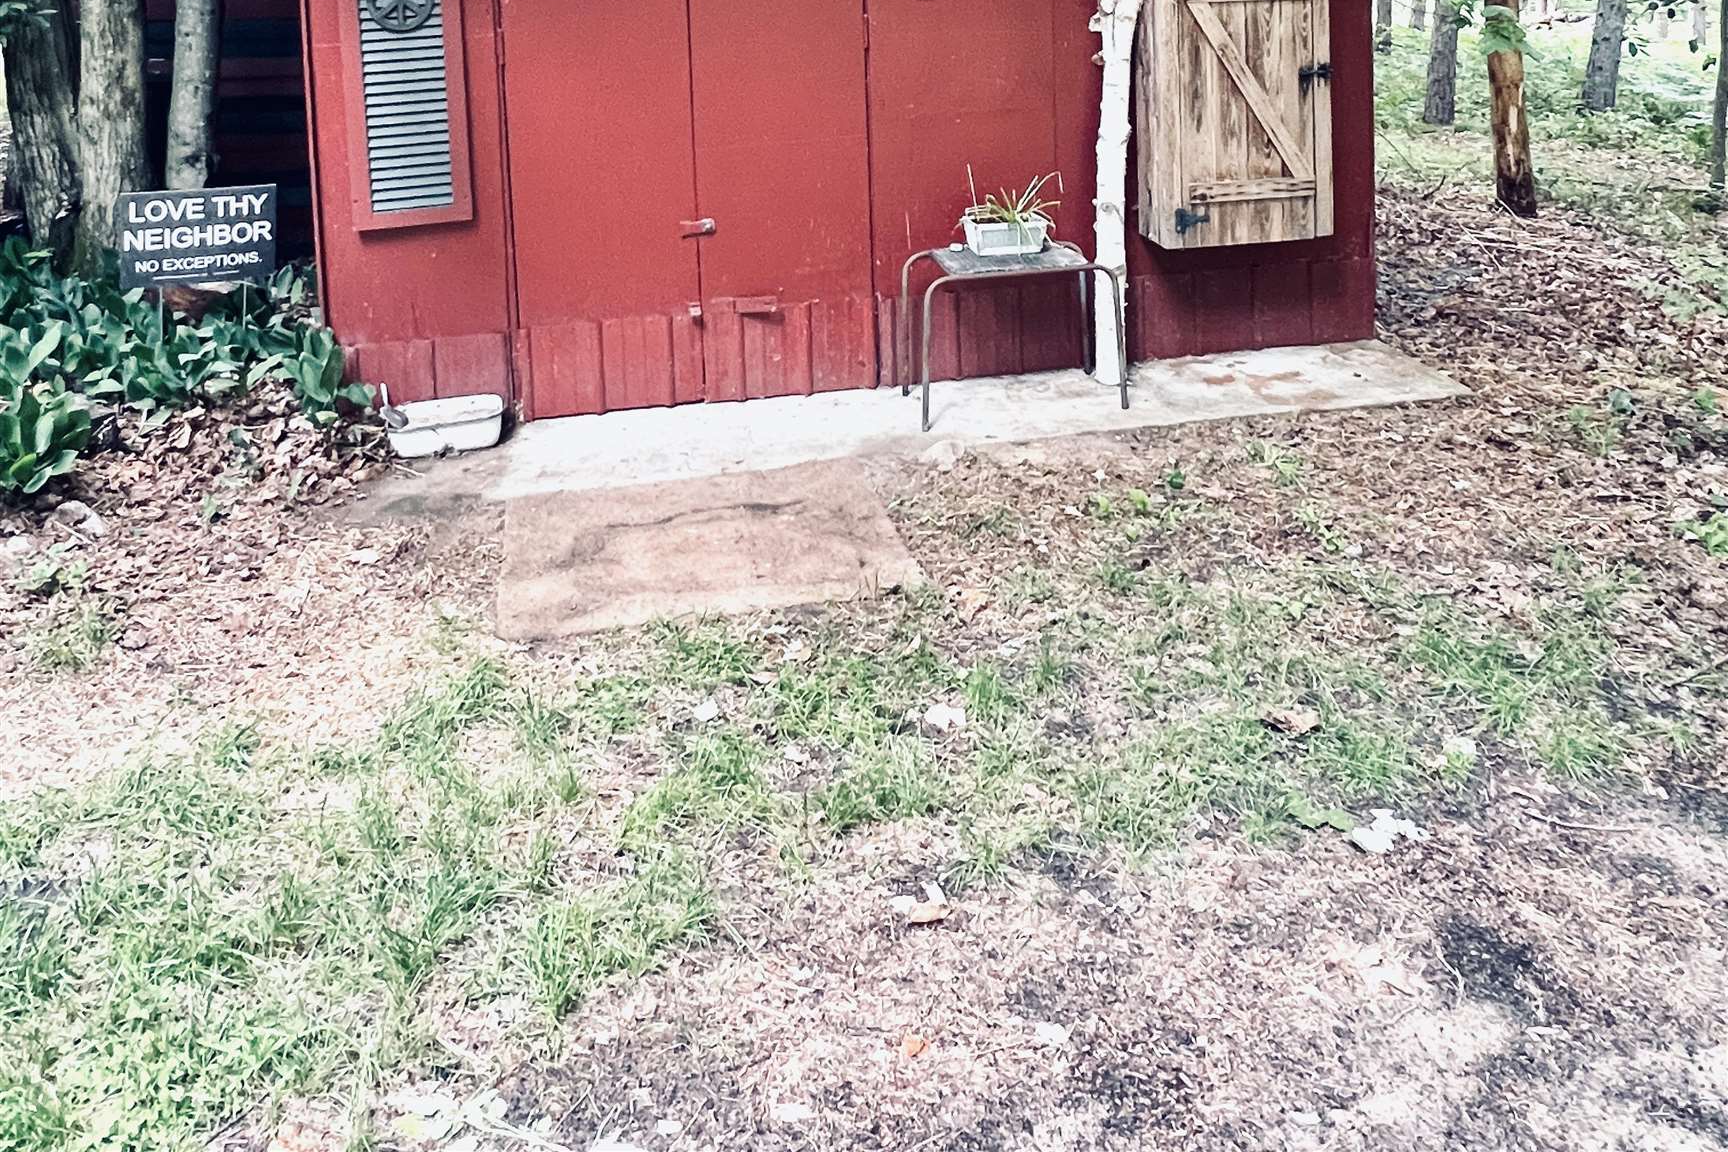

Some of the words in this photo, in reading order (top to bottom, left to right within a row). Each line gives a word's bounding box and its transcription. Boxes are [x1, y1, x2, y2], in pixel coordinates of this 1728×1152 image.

[128, 197, 206, 224] LOVE
[211, 192, 269, 218] THY
[123, 220, 273, 252] NEIGHBOR
[135, 259, 160, 273] NO
[162, 250, 263, 272] EXCEPTIONS.
